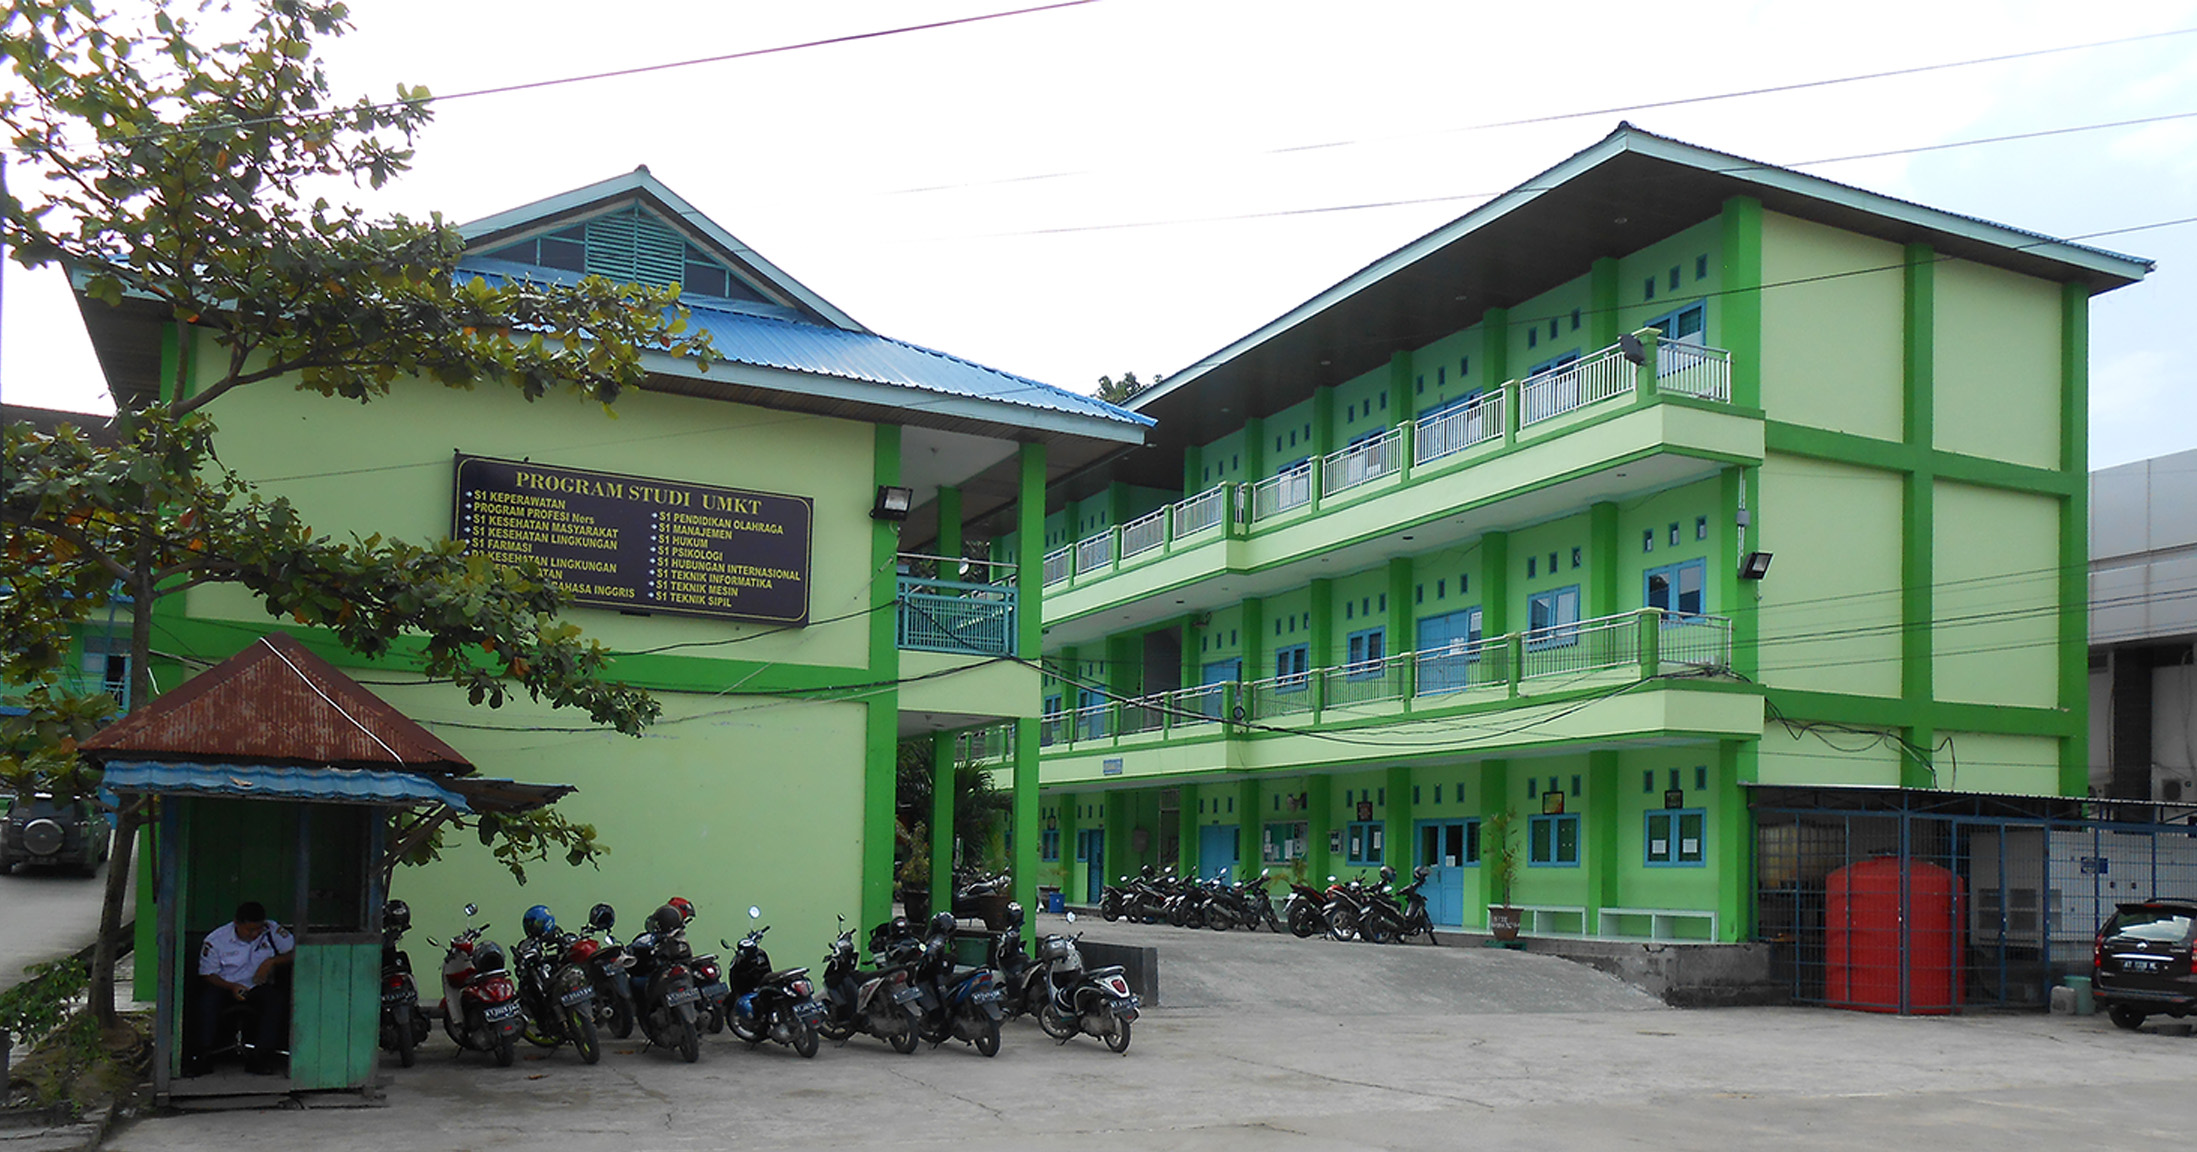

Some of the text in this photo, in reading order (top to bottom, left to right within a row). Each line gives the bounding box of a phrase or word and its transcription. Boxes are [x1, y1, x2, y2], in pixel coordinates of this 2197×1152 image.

[474, 490, 566, 509] S1 KEPERAWATAN
[515, 471, 762, 514] PROGRAM STUDI UMKT
[474, 502, 594, 524] PROGRAM PROFESI Ners
[473, 514, 618, 538] S1 KESEHATAN MASYARAKAT
[659, 512, 784, 534] S1 PENDIDIKAN OLAHRAGA
[659, 523, 732, 540] S1 MANAJEMEN
[472, 538, 532, 552] S1 FARMASI
[473, 527, 618, 550] S1 KESEHATAN LINGKUNGAN
[658, 534, 708, 548] S1 HUKUM
[489, 552, 548, 566] KESEHATAN
[551, 558, 616, 572] LINGKUNGAN
[658, 546, 723, 561] S1 PSIKOLOGI
[658, 558, 800, 580] S1 HUBUNGAN INTERNASIONAL
[656, 580, 738, 596] S1 TEKNIK MESIN
[657, 569, 772, 589] S1 TEKNIK INFORMATIKA
[594, 586, 635, 598] INGGRIS
[656, 592, 732, 607] S1 TEKNIK SIPIL
